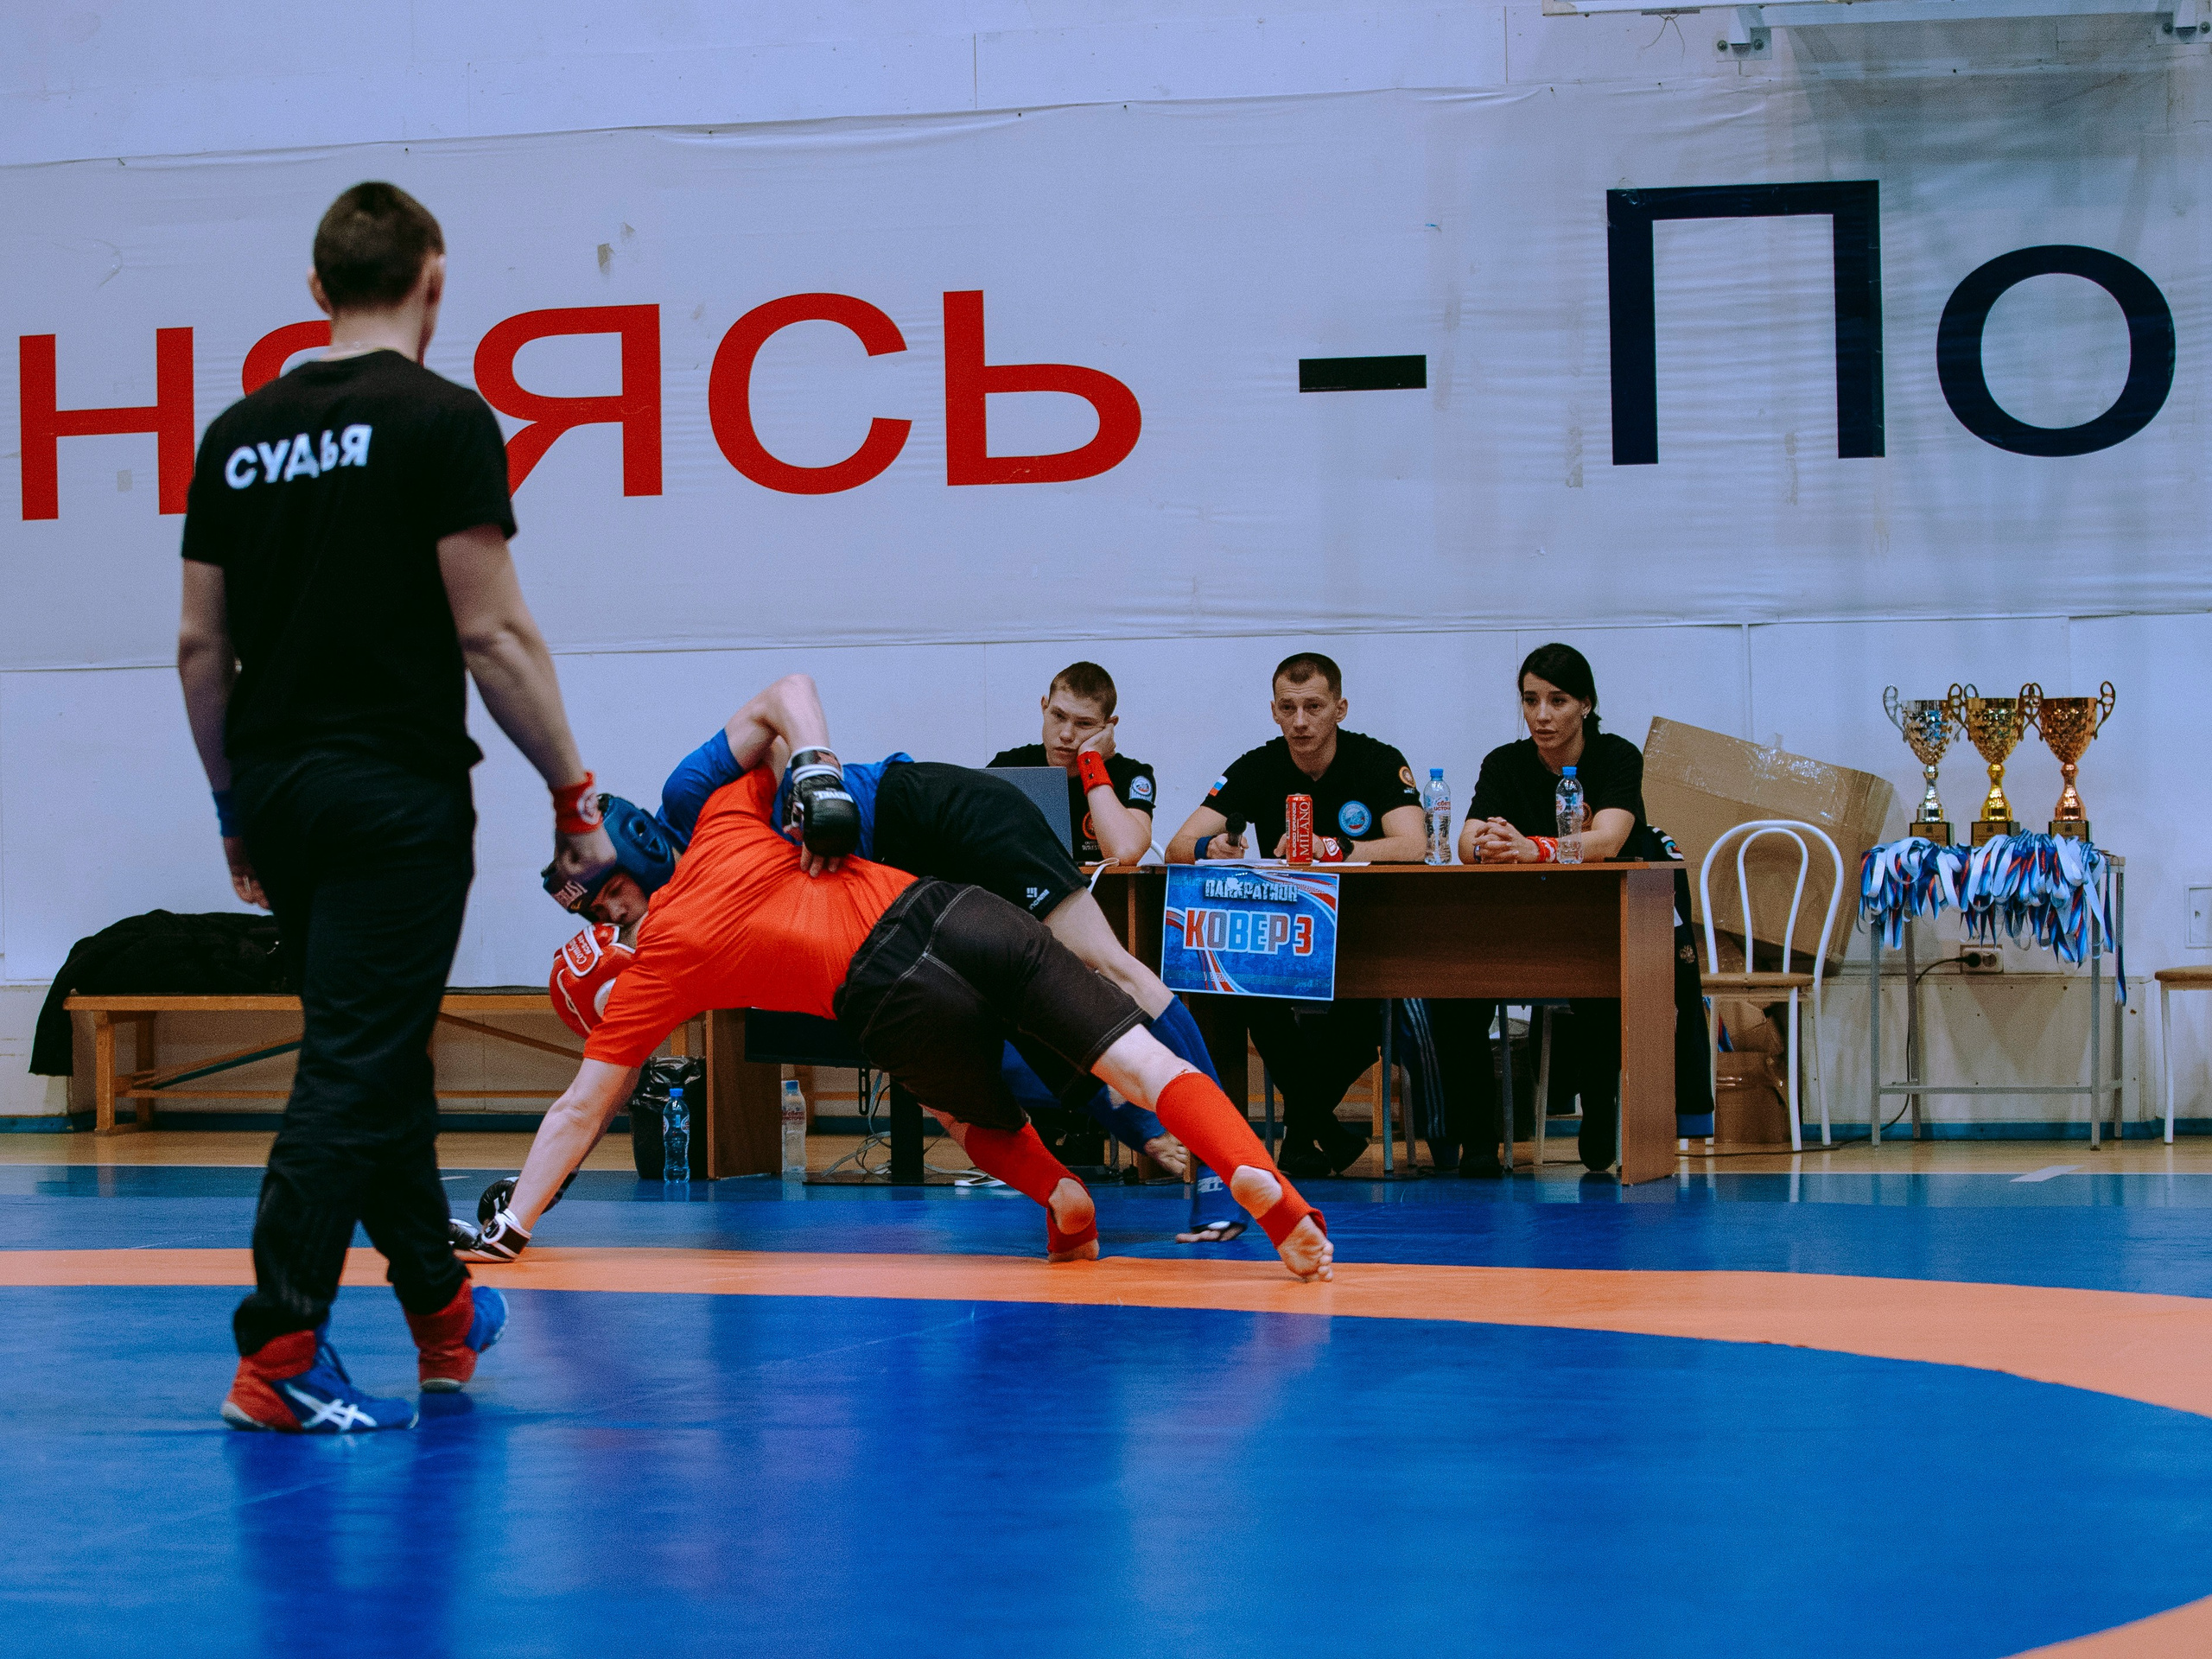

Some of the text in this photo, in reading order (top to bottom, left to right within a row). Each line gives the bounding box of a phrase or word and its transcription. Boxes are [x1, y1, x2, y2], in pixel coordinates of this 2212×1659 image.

[19, 289, 1142, 521] нясь
[1606, 179, 2177, 465] По
[224, 423, 373, 490] СУДЬЯ
[1299, 801, 1311, 855] MILANO
[1183, 907, 1315, 957] КОВЕР 3
